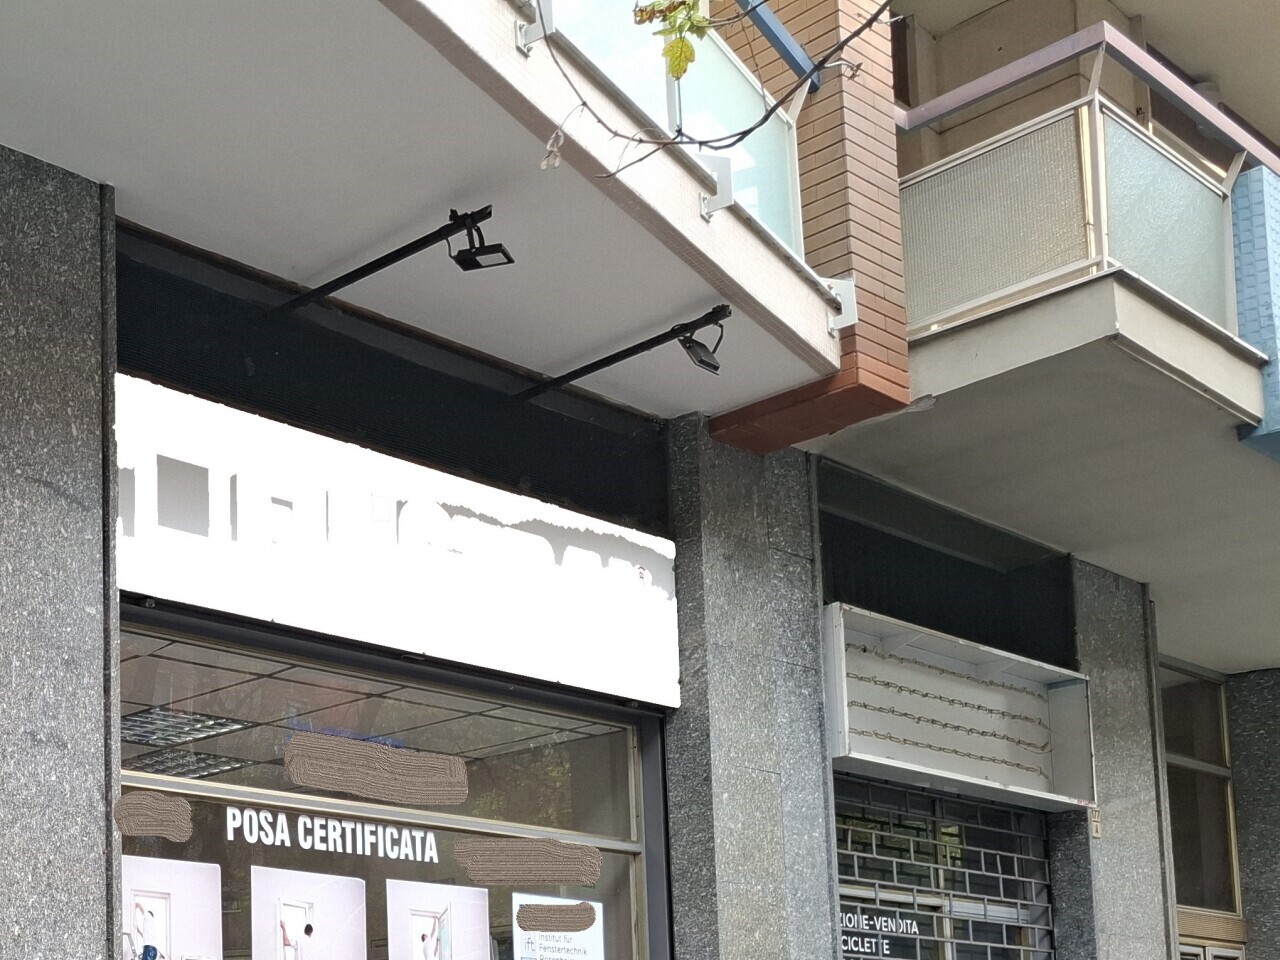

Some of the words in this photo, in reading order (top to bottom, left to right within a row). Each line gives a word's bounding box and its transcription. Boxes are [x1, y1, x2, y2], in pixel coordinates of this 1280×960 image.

[227, 806, 291, 848] POSA
[298, 814, 440, 864] CERTIFICATA
[524, 938, 535, 952] ift
